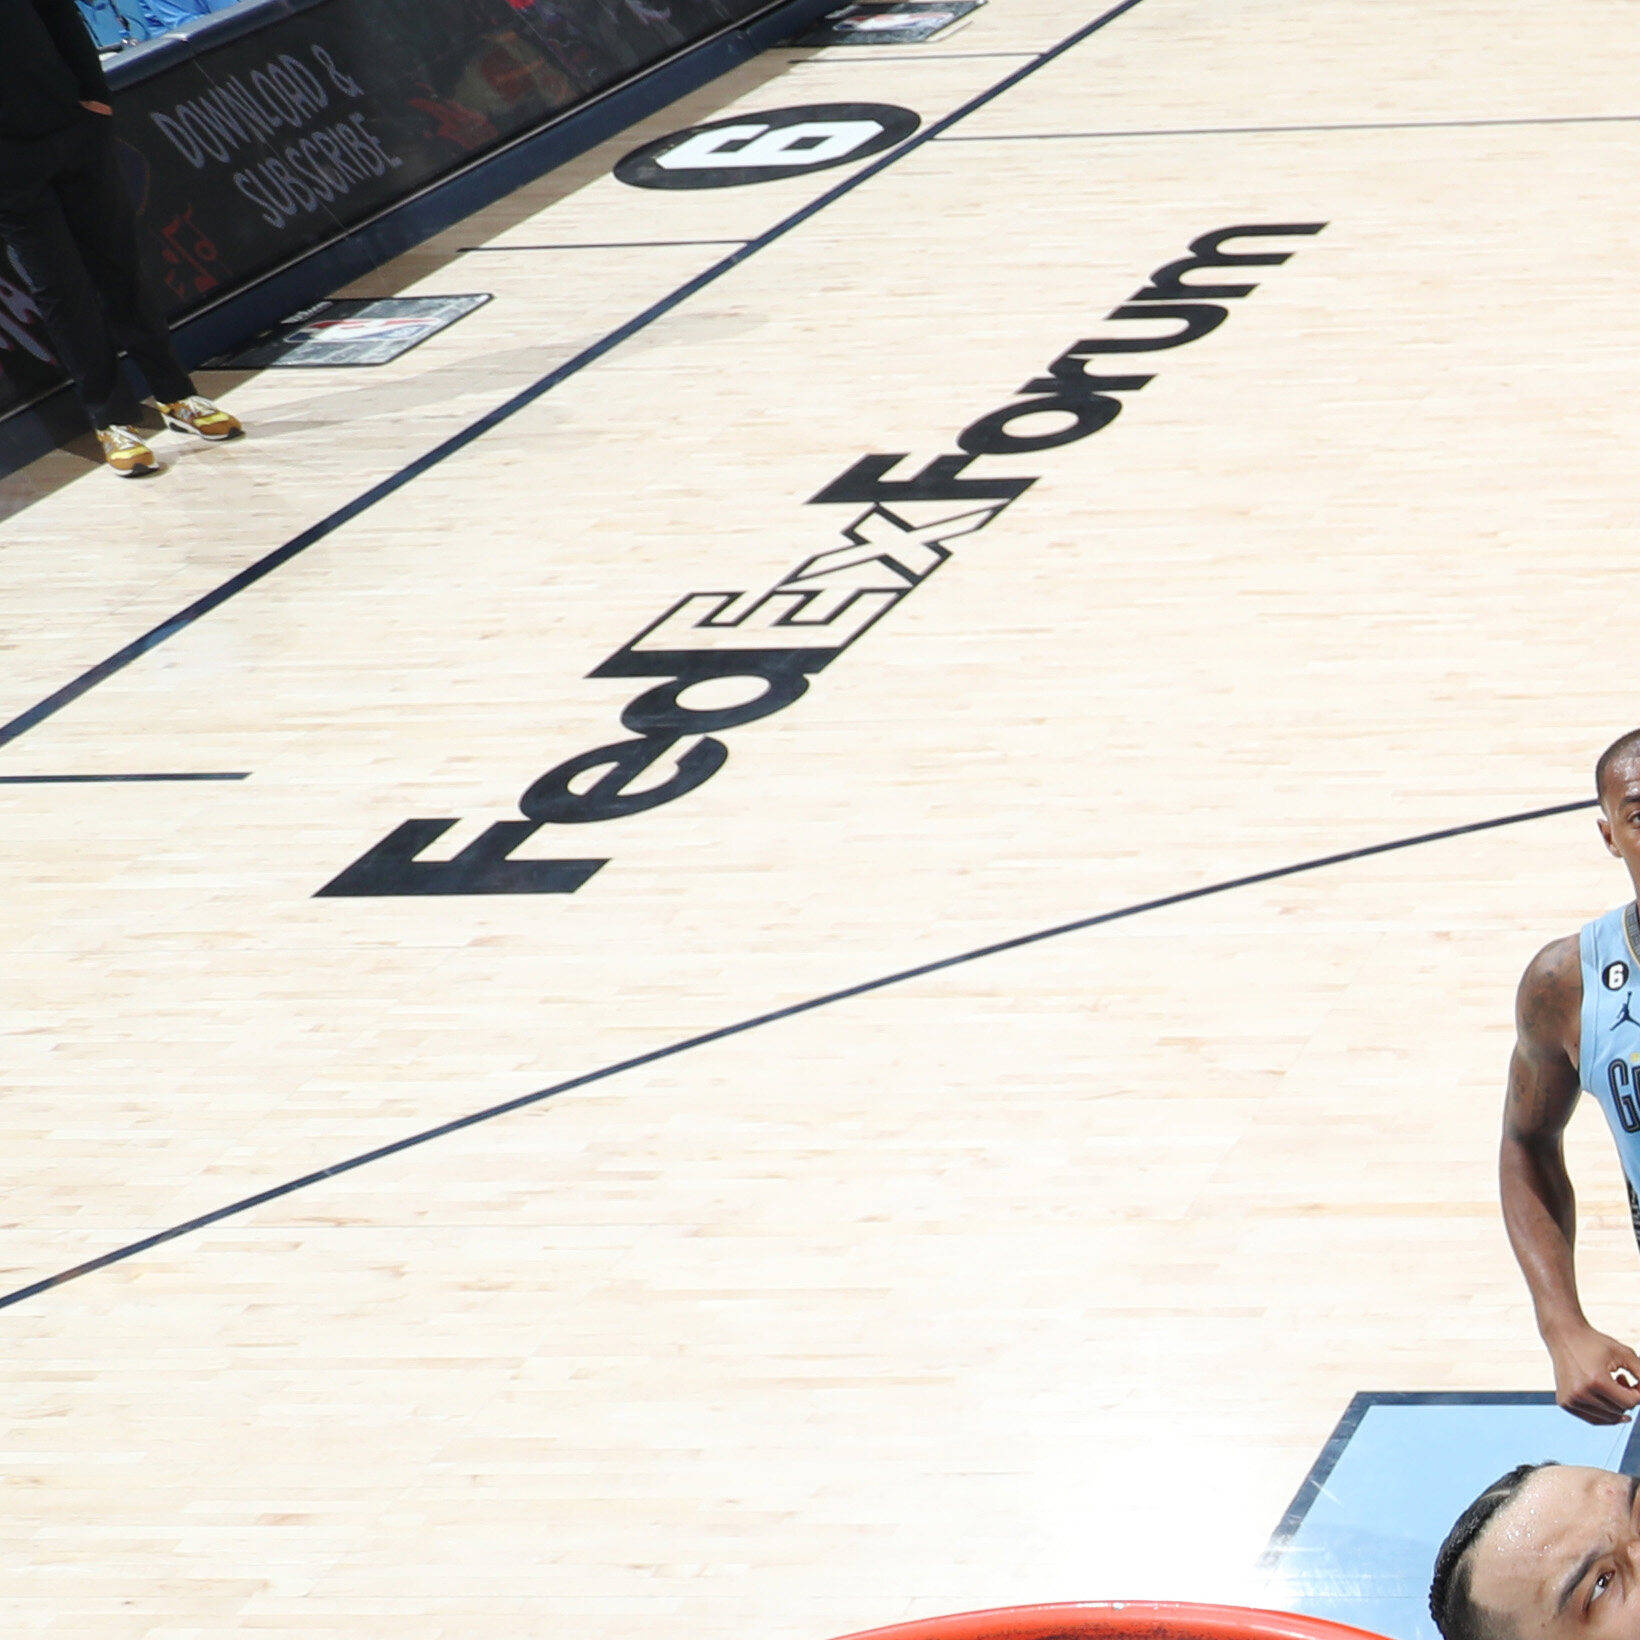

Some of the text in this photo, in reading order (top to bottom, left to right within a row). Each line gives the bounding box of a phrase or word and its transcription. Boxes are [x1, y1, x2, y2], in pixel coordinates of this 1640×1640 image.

[150, 44, 364, 168] DOWNLOAD &
[233, 112, 402, 229] SUBSCRIBE
[312, 222, 1330, 897] FedExForum
[1607, 963, 1625, 987] 6
